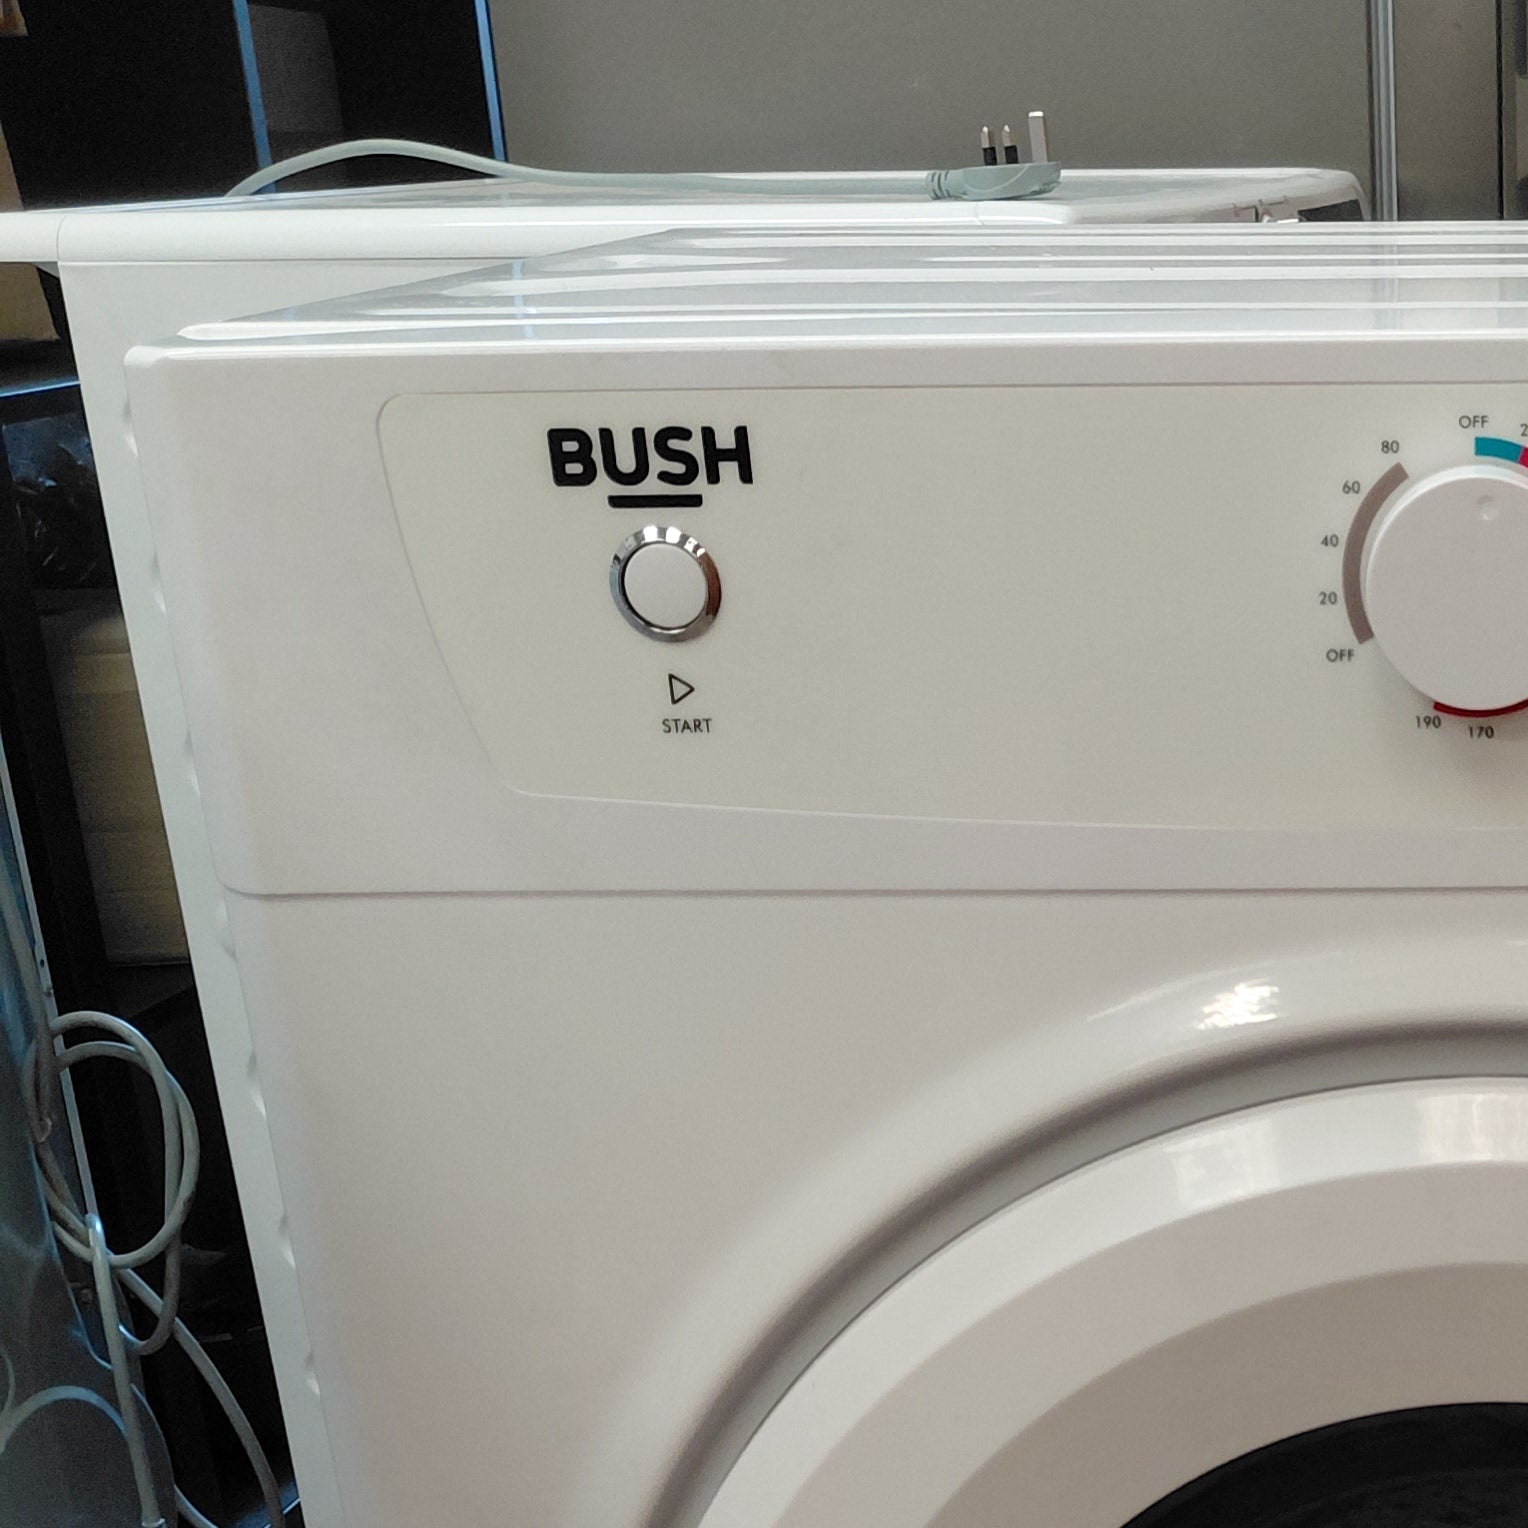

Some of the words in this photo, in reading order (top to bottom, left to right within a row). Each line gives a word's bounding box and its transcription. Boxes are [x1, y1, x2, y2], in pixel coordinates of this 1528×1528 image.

[1458, 415, 1489, 429] OFF
[1380, 440, 1400, 454] 80
[547, 426, 753, 487] BUSH
[1341, 480, 1361, 495] 60
[1320, 534, 1339, 548] 40
[1318, 591, 1338, 606] 20
[1326, 649, 1355, 663] OFF
[662, 718, 712, 733] START
[1414, 715, 1442, 730] 190
[1468, 725, 1494, 740] 170
